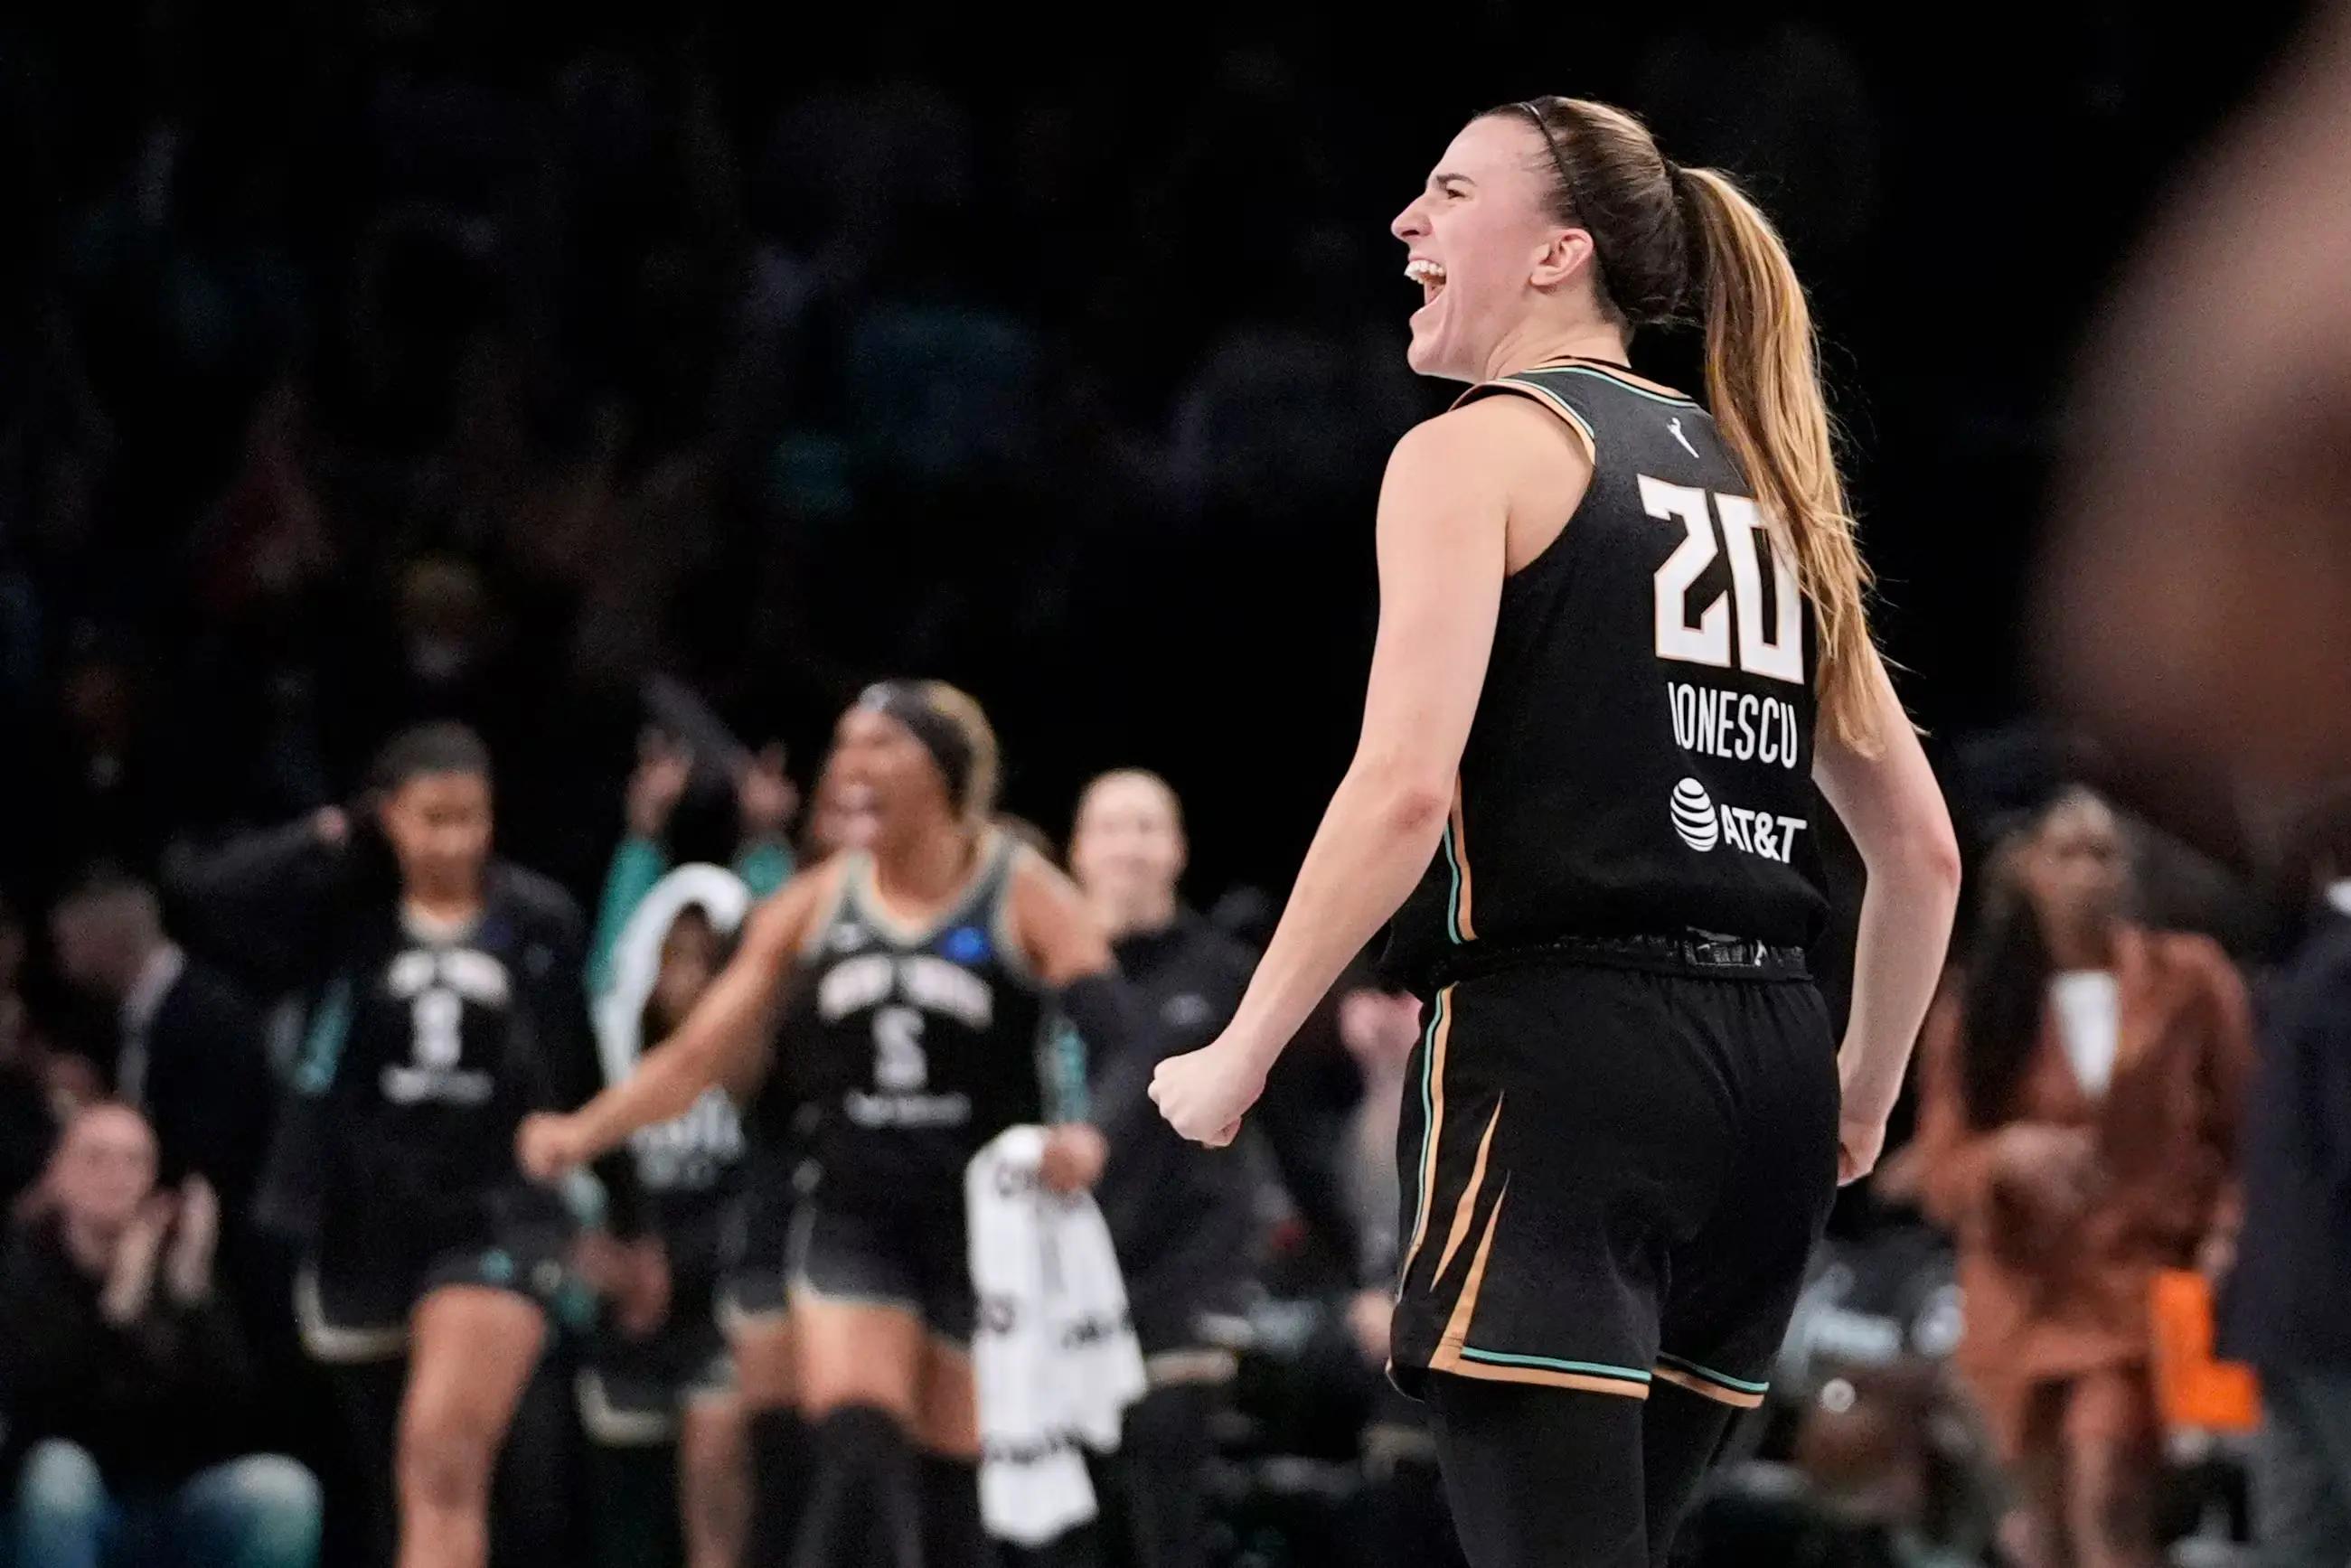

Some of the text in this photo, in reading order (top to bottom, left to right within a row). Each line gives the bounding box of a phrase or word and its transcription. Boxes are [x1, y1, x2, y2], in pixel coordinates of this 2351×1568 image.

[1636, 473, 1805, 685] 20
[1668, 681, 1798, 769] IONESCU
[1720, 803, 1807, 864] AT&T
